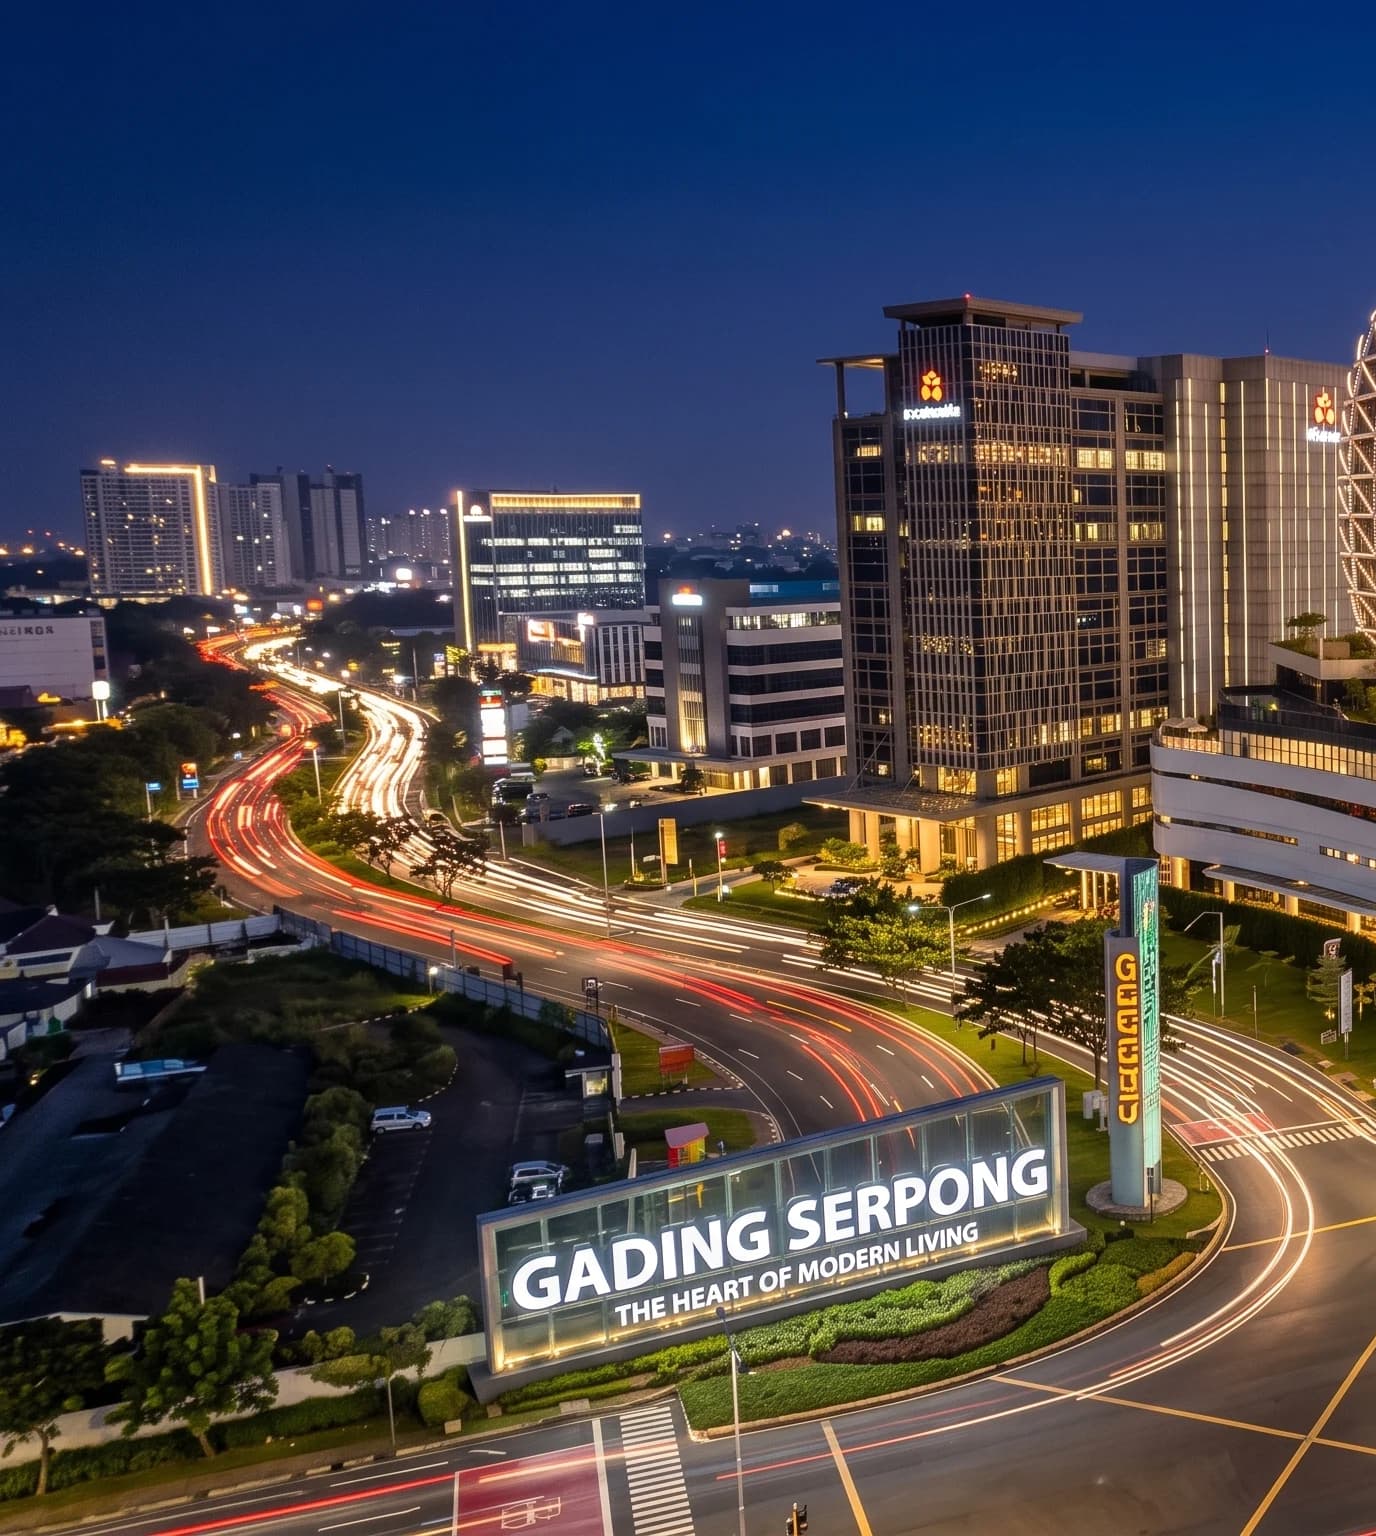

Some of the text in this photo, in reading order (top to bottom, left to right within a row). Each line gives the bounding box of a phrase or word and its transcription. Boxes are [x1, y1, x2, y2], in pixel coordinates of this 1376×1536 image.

[511, 1148, 1049, 1311] GADING SERPONG
[614, 1221, 980, 1327] THE HEART OF MODERN LIVING
